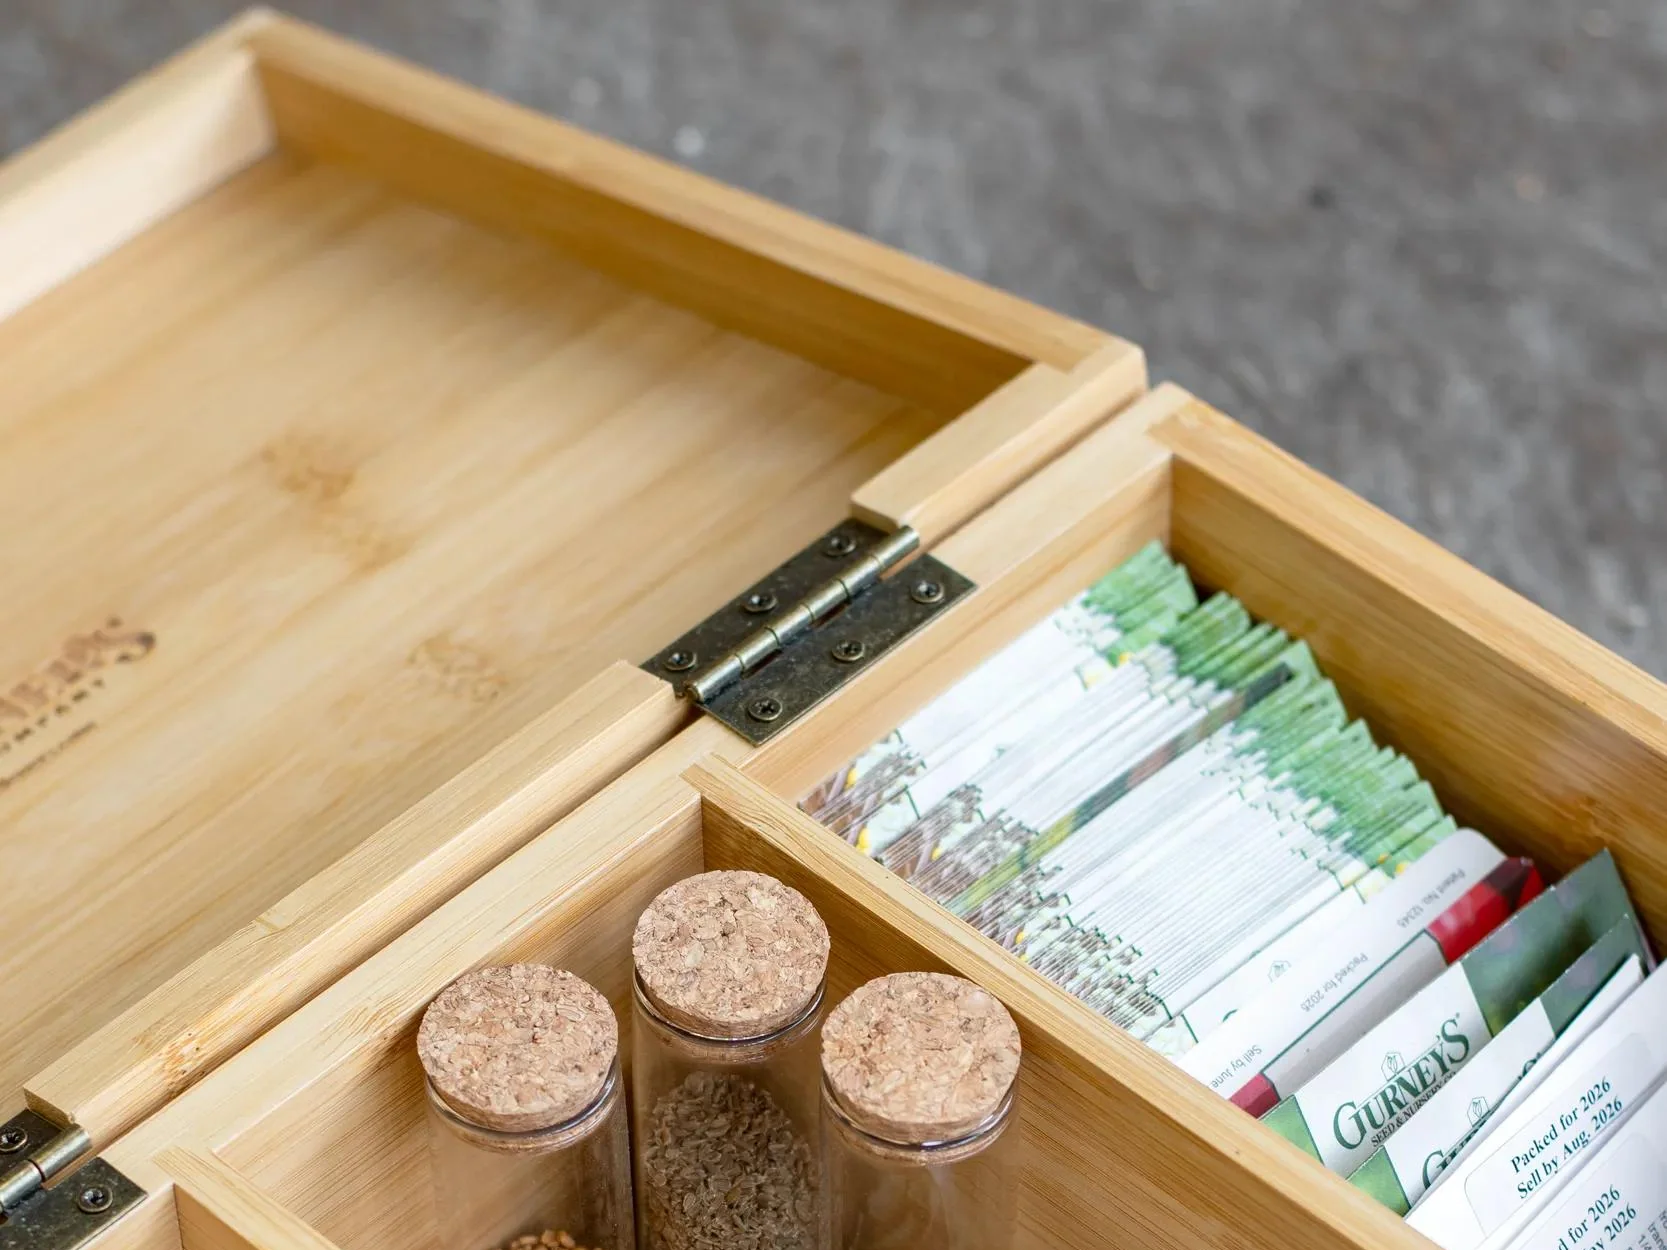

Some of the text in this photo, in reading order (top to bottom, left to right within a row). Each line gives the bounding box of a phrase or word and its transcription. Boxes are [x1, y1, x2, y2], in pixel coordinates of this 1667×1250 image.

[1322, 979, 1338, 992] for
[1334, 952, 1369, 983] Packed
[1210, 1044, 1262, 1088] Sell by June
[1371, 1122, 1395, 1147] SEED
[1510, 1075, 1611, 1174] Packed for 2026
[1517, 1094, 1623, 1199] Sell by Aug. 2026
[1567, 1219, 1590, 1245] for
[1587, 1183, 1621, 1223] 2026
[1603, 1202, 1637, 1241] 2026
